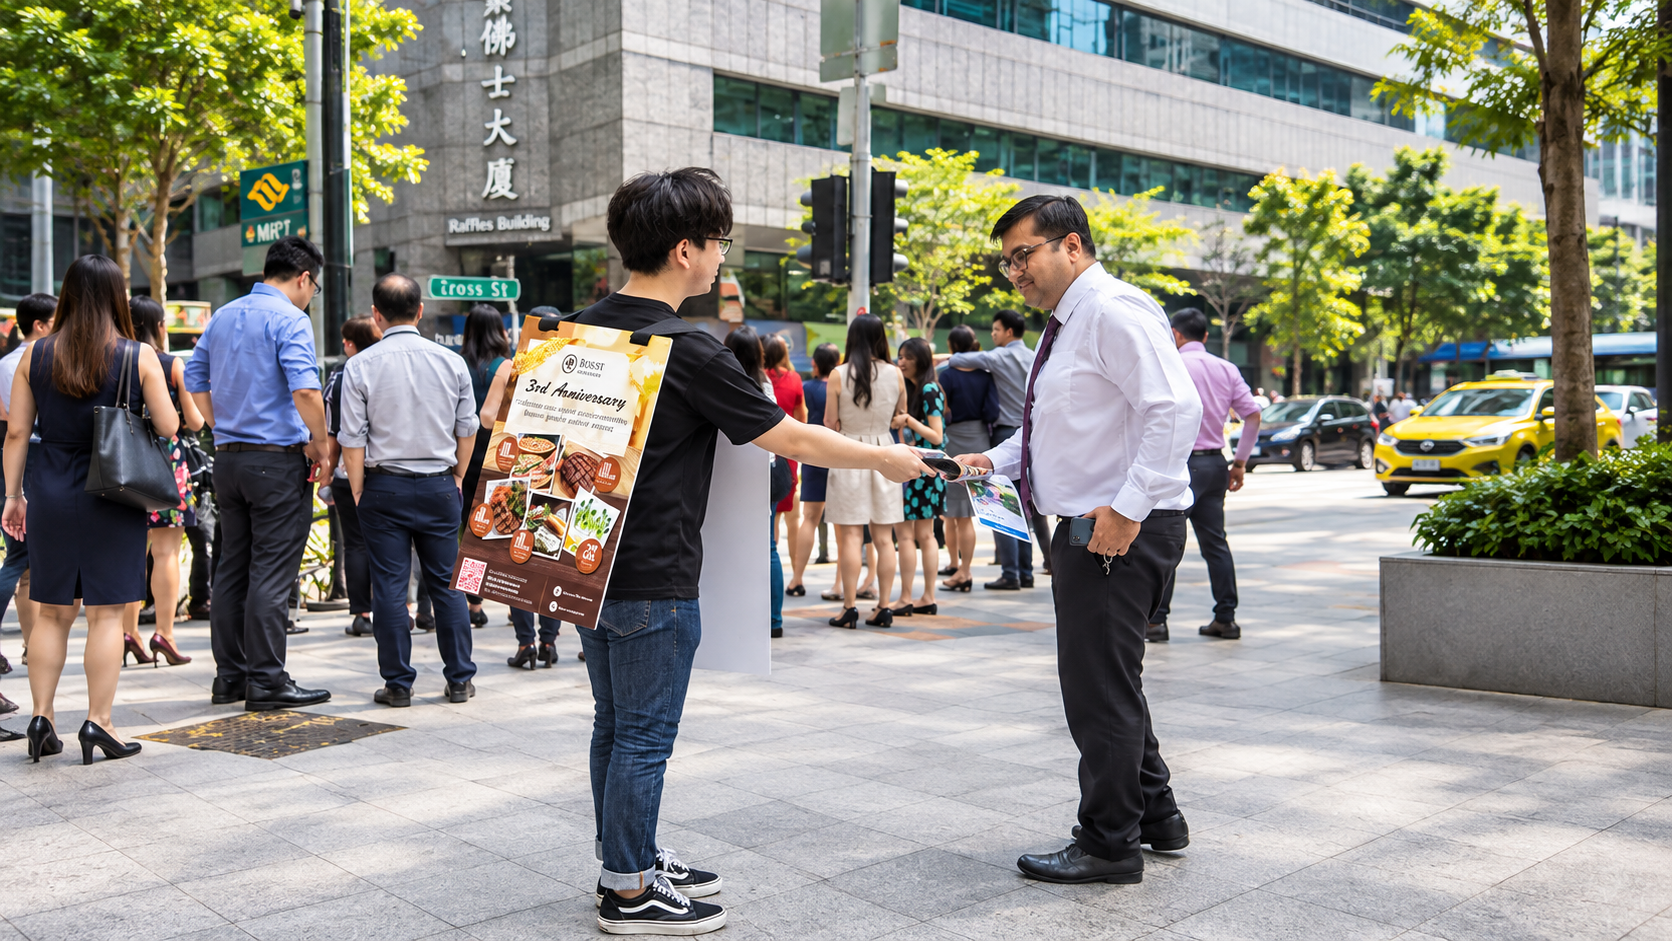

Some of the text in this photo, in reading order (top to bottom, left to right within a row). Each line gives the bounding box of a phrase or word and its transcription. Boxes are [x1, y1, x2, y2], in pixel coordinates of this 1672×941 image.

[257, 219, 291, 243] MRT
[448, 215, 551, 234] Raffles Building
[491, 281, 508, 298] St
[525, 378, 551, 395] 3rd
